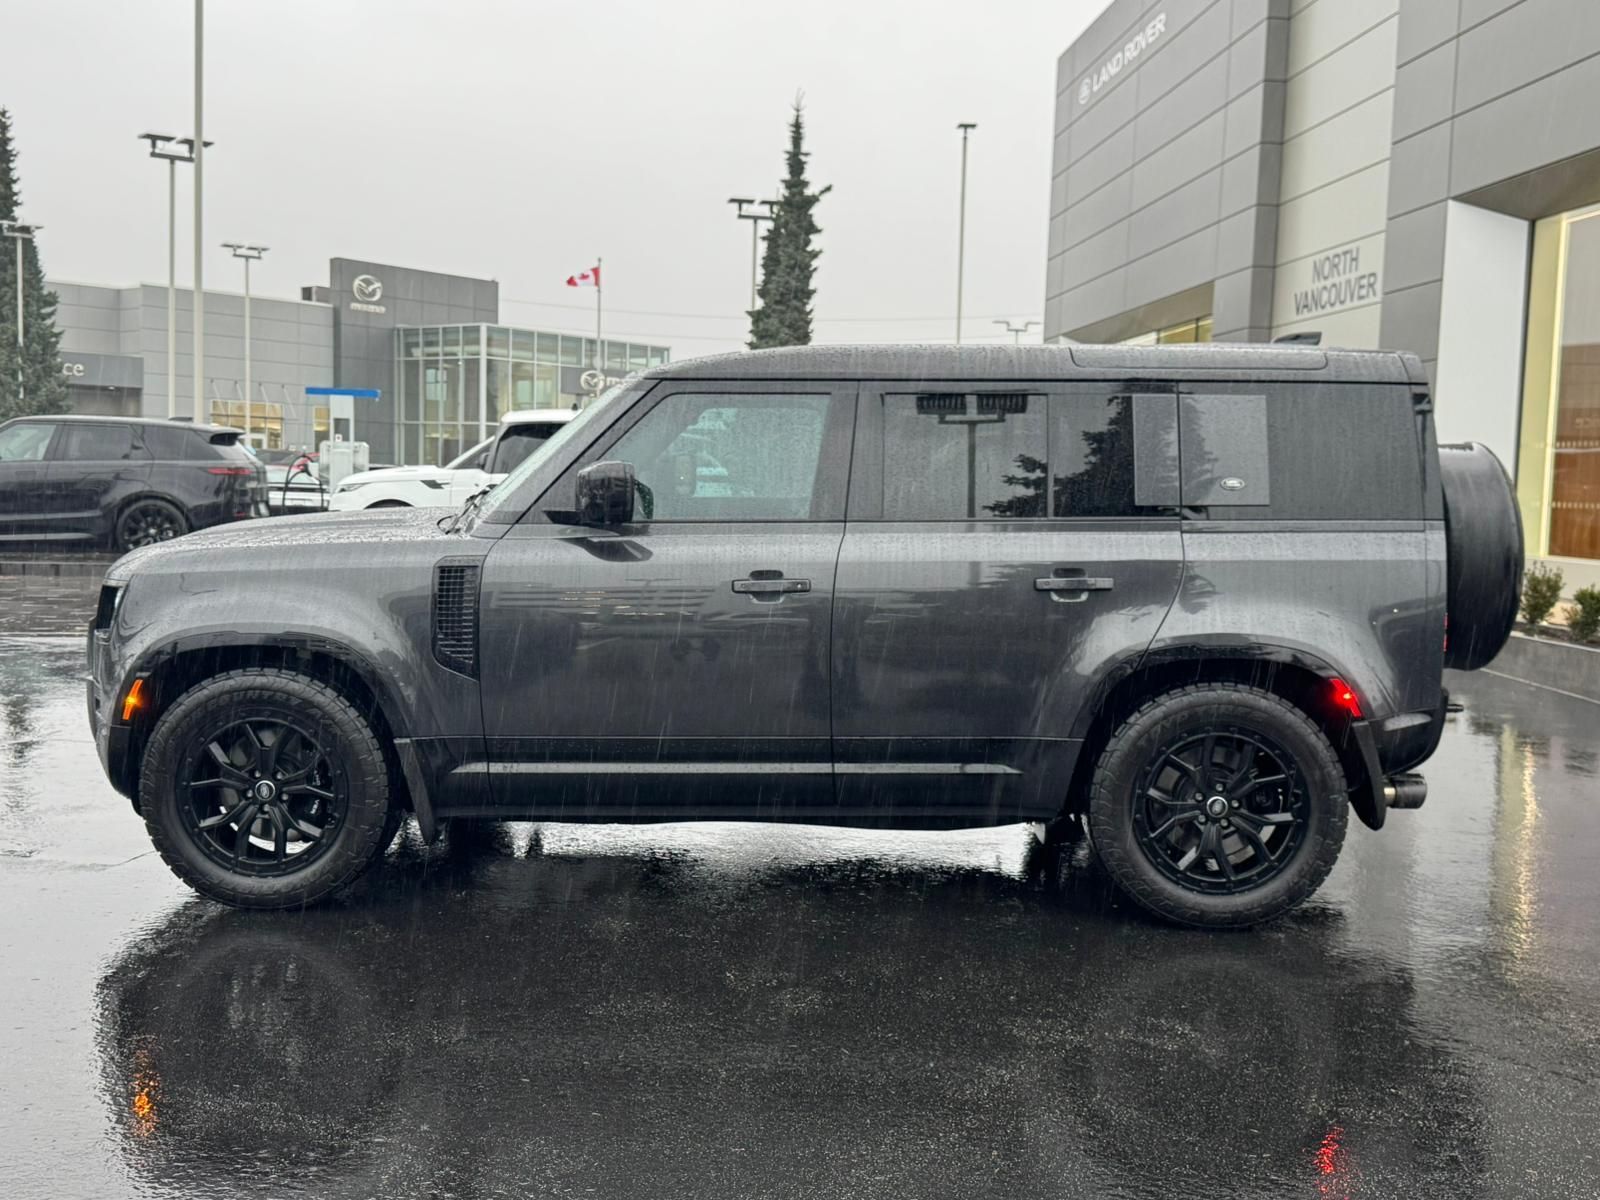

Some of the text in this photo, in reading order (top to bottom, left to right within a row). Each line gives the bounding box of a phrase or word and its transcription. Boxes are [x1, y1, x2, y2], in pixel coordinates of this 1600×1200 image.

[1093, 51, 1123, 92] LAND
[1124, 12, 1166, 65] ROVER
[1312, 247, 1360, 285] NORTH
[1294, 272, 1377, 316] VANCOUVER
